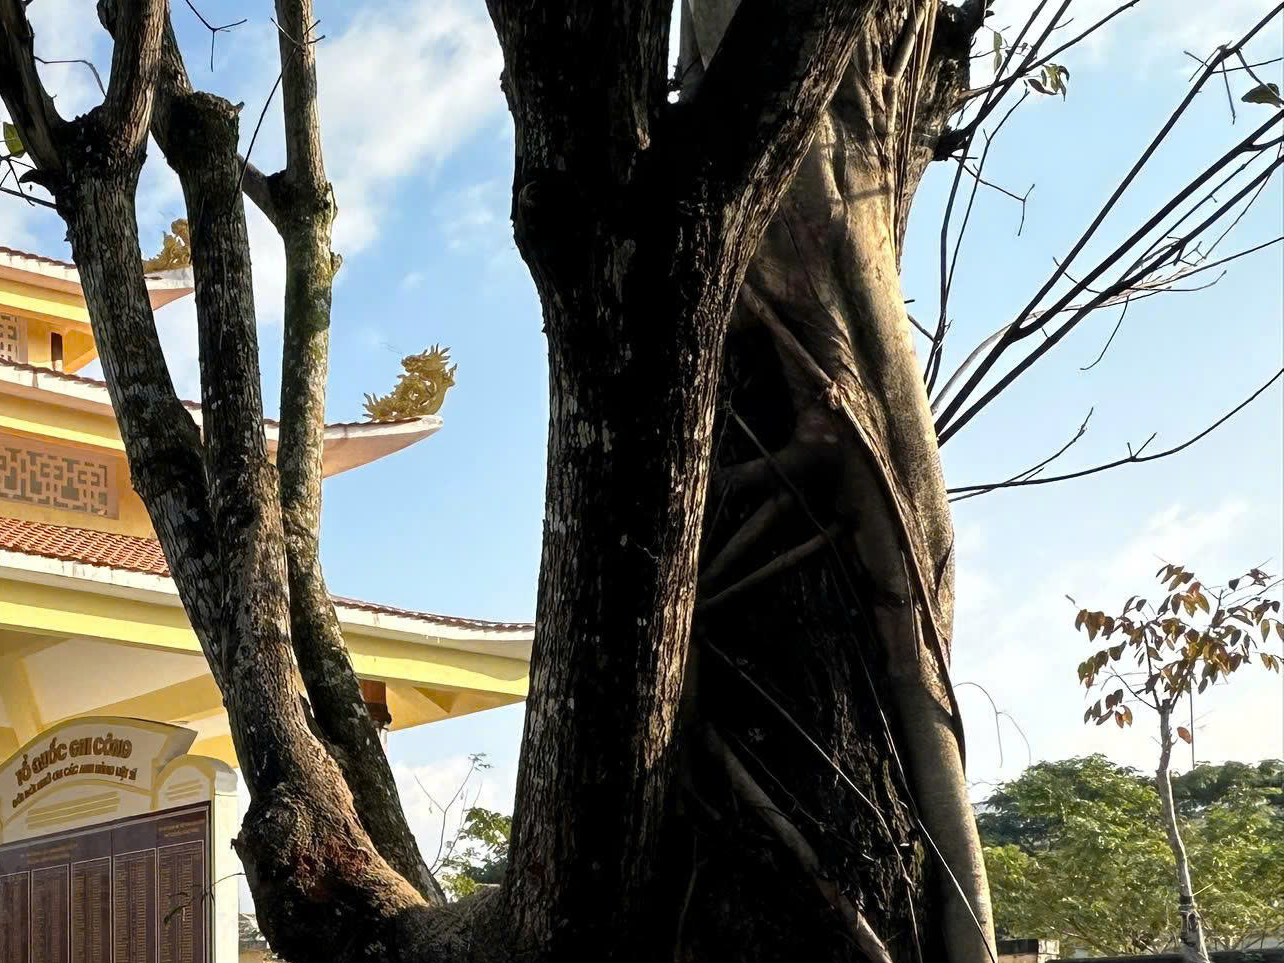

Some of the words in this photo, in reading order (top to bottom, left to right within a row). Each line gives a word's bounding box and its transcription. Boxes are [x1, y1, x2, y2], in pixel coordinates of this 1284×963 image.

[15, 754, 31, 786] TỔ
[32, 737, 67, 773] QUỐC
[69, 738, 92, 757] GHI
[93, 733, 132, 758] CÔNG
